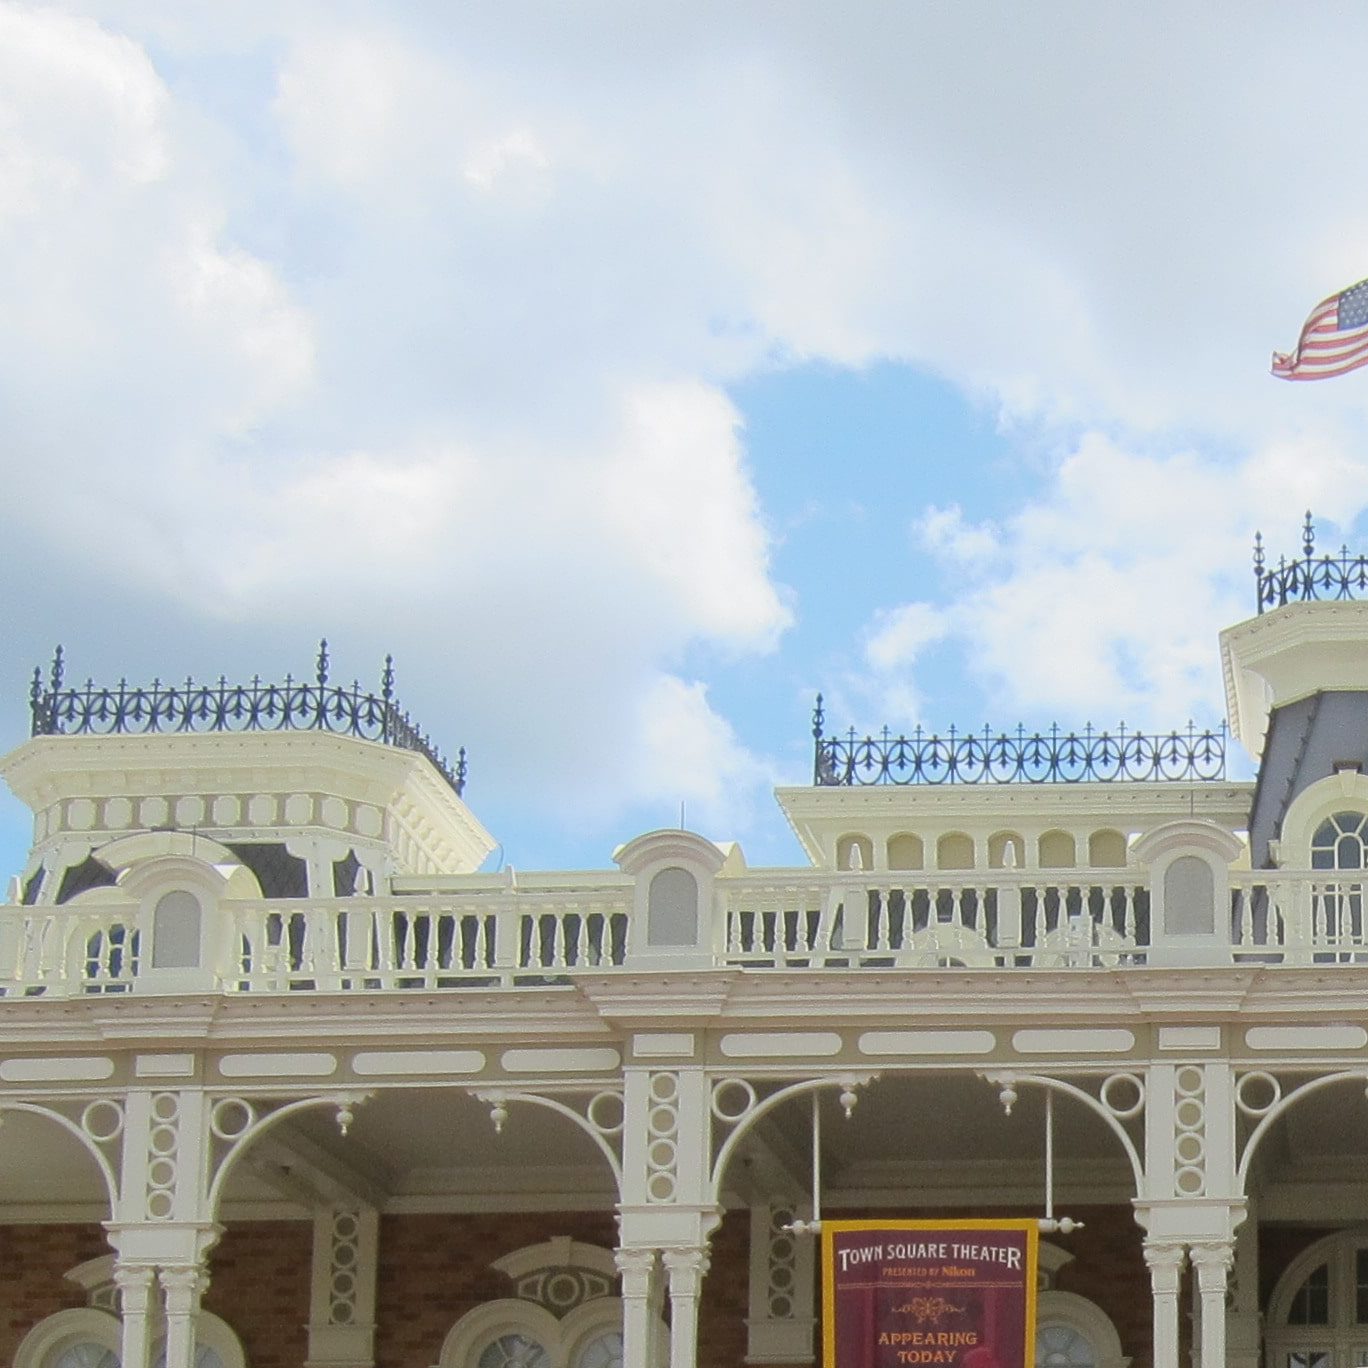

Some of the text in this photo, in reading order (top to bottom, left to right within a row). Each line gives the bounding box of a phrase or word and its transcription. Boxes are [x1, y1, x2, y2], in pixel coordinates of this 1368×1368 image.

[838, 1243, 1021, 1271] TOWN SQUARE THEATER
[882, 1265, 976, 1277] PRESENTED BY Nikon
[878, 1331, 978, 1346] APPEARING
[897, 1350, 957, 1364] TODAY
